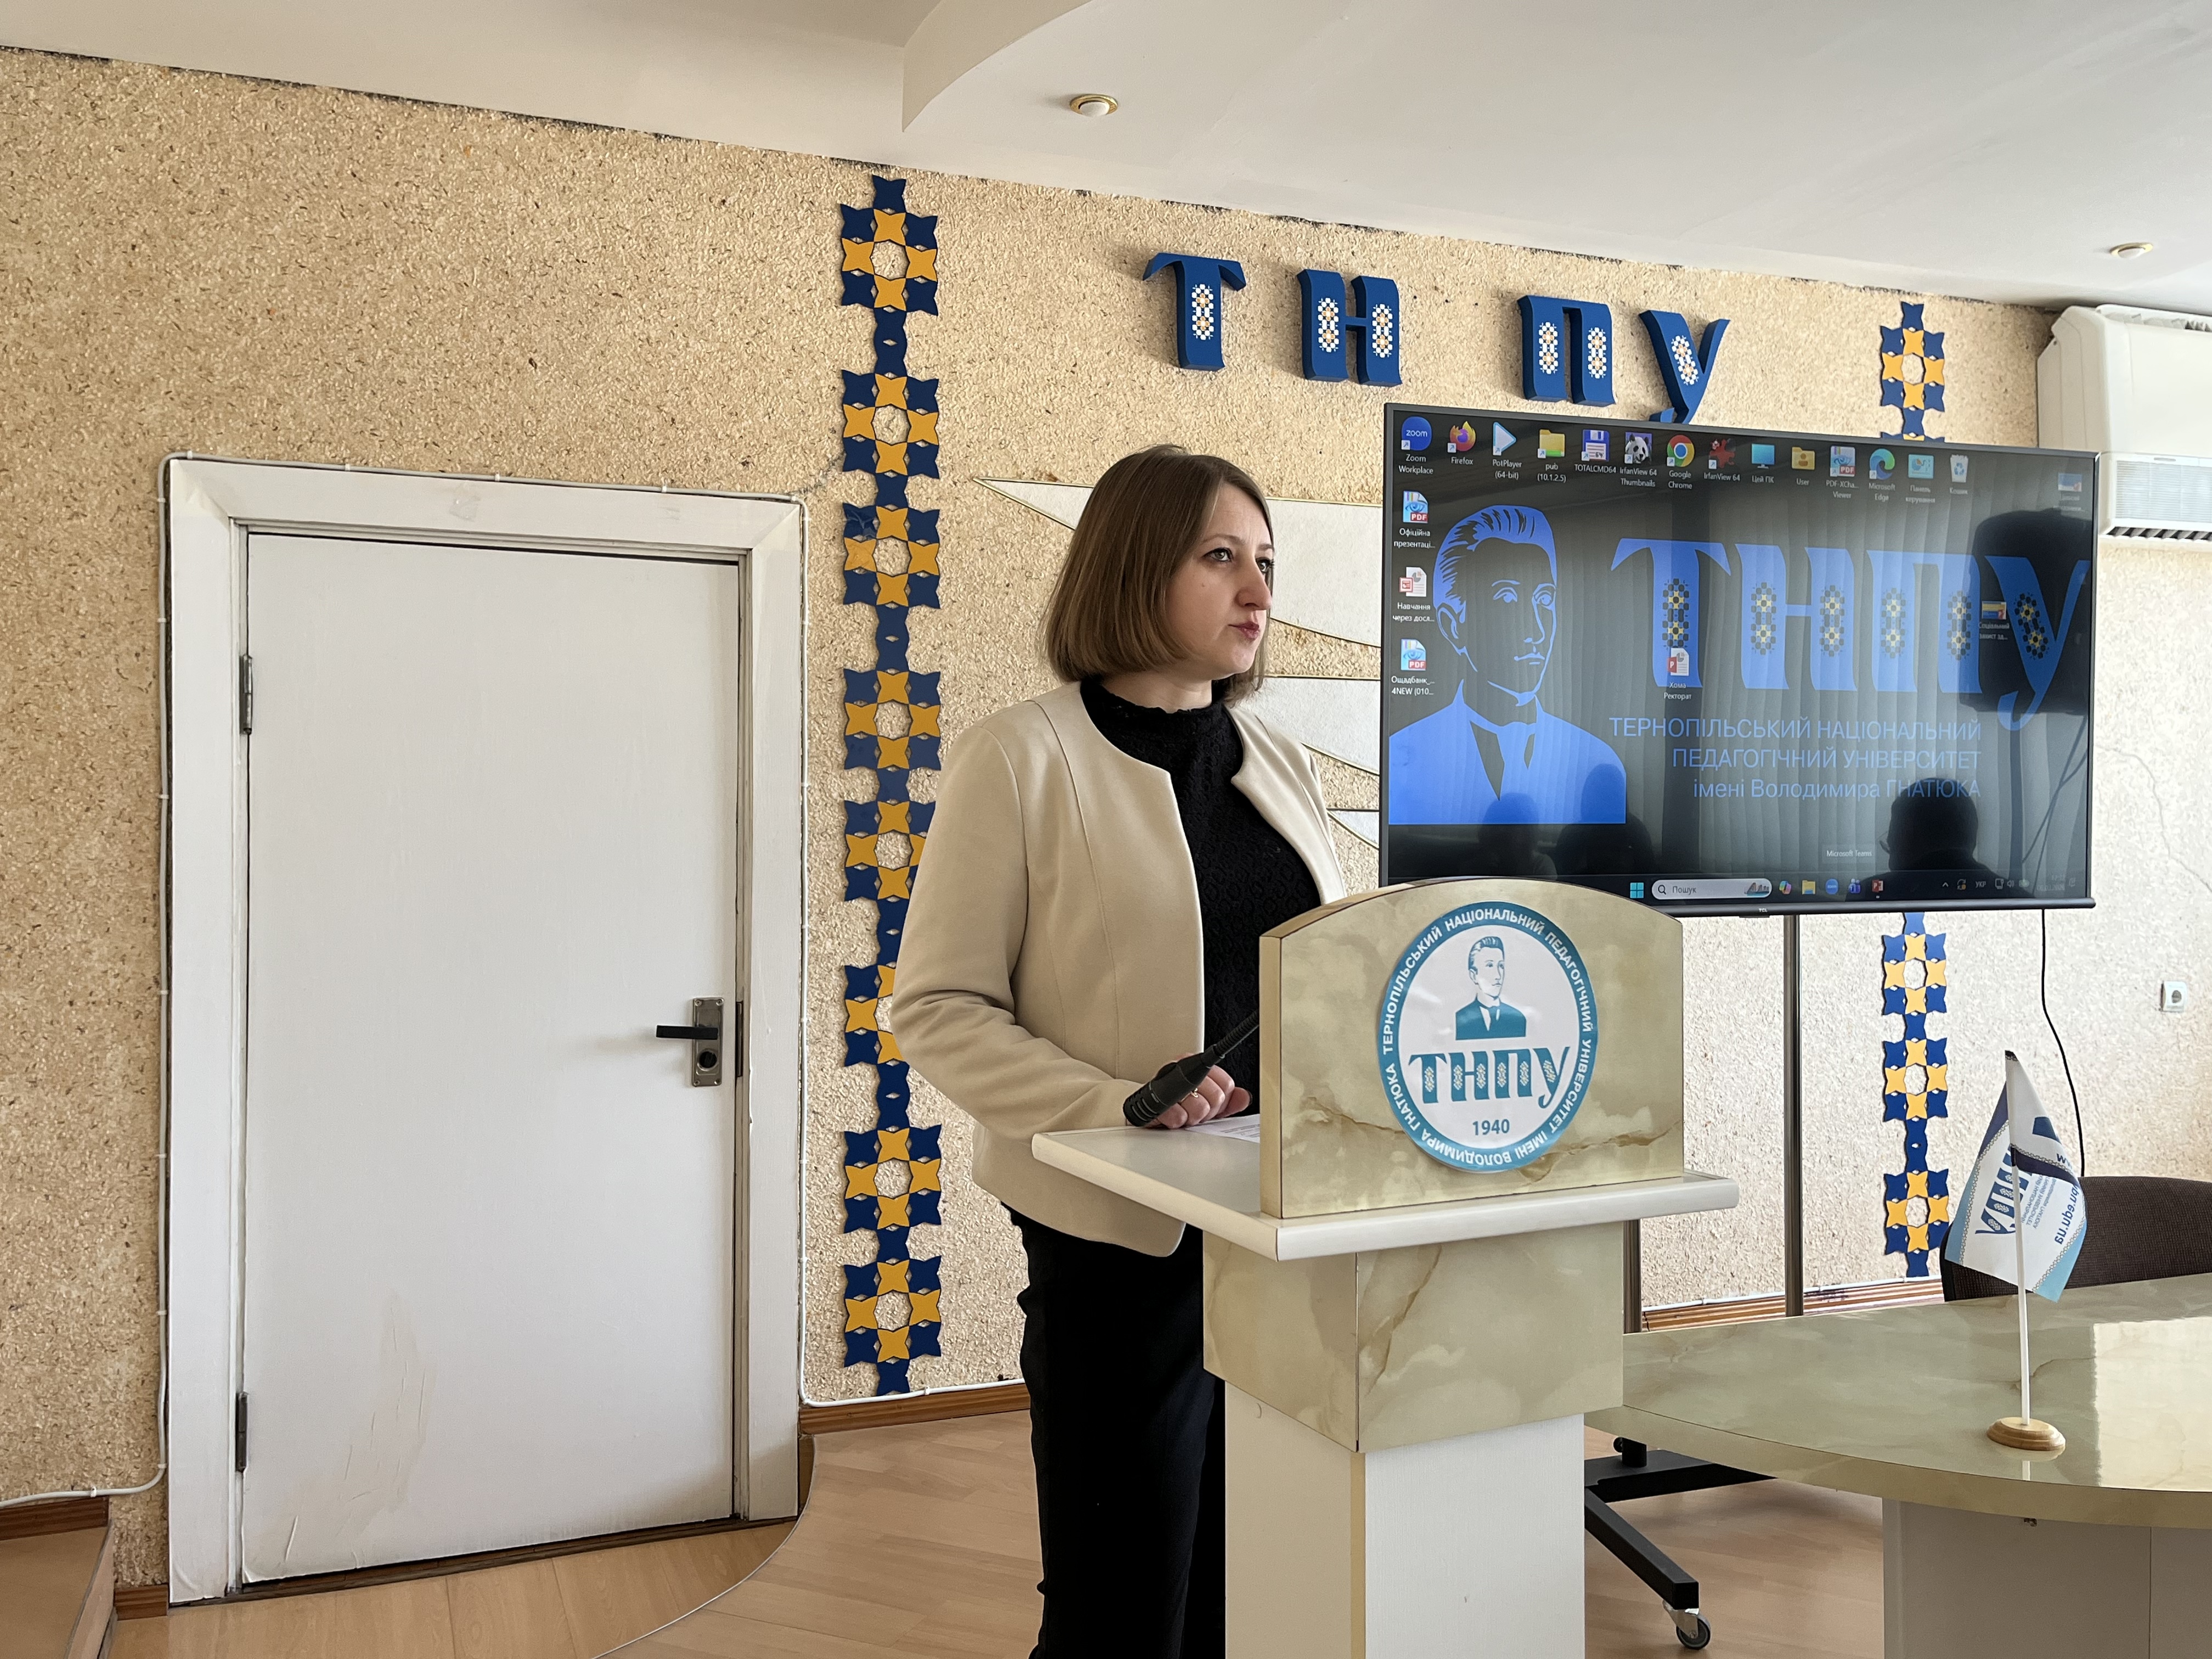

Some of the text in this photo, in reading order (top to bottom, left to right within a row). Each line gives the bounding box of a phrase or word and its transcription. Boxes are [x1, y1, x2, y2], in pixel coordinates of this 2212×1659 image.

[1406, 454, 1426, 462] Zoom
[1451, 456, 1474, 465] Firefox
[1492, 459, 1522, 468] PotPlayer
[1545, 462, 1559, 471] pub
[1574, 464, 1616, 473] TOTALCMD64
[1398, 465, 1434, 475] Workplace
[1495, 470, 1519, 480] (64-bit)
[1620, 466, 1657, 476] IrfanView 64
[1669, 470, 1692, 479] Google
[1537, 473, 1567, 483] (10.1.2.5)
[1703, 472, 1741, 482] IrfanView 64
[1796, 478, 1809, 486] User
[1620, 478, 1656, 488] Thumbnails
[1668, 481, 1693, 489] Chrome
[1869, 482, 1895, 492] Microsoft
[1875, 493, 1889, 503] Edge
[1399, 528, 1431, 538] Офіційна
[1397, 601, 1431, 611] Навчання
[1392, 615, 1413, 623] через
[1611, 538, 2091, 730] ТНПУ
[1391, 687, 1413, 696] 4NEW
[1663, 692, 1692, 701] Ректорат
[1609, 716, 1982, 742] ТЕРНОПІЛЬСЬКИЙ НАЦІОНАЛЬНИЙ
[1673, 746, 1982, 771] ПЕДАГОГІЧНИЙ УНІВЕРСИТЕТ
[1694, 778, 1981, 802] імені Володимира ГНАТЮКА
[1672, 885, 1697, 896] Пошук
[1383, 907, 1593, 1167] ТЕРНОПІЛЬСЬКИЙ НАЦІОНАЛЬНИЙ ПЕДАГОГІЧНИЙ УНІВЕРСИТЕТ ІМЕНІ ВОЛОДИМИРА ГНАТЮКА
[1408, 1046, 1571, 1109] ТНПУ
[1472, 1119, 1510, 1136] 1940
